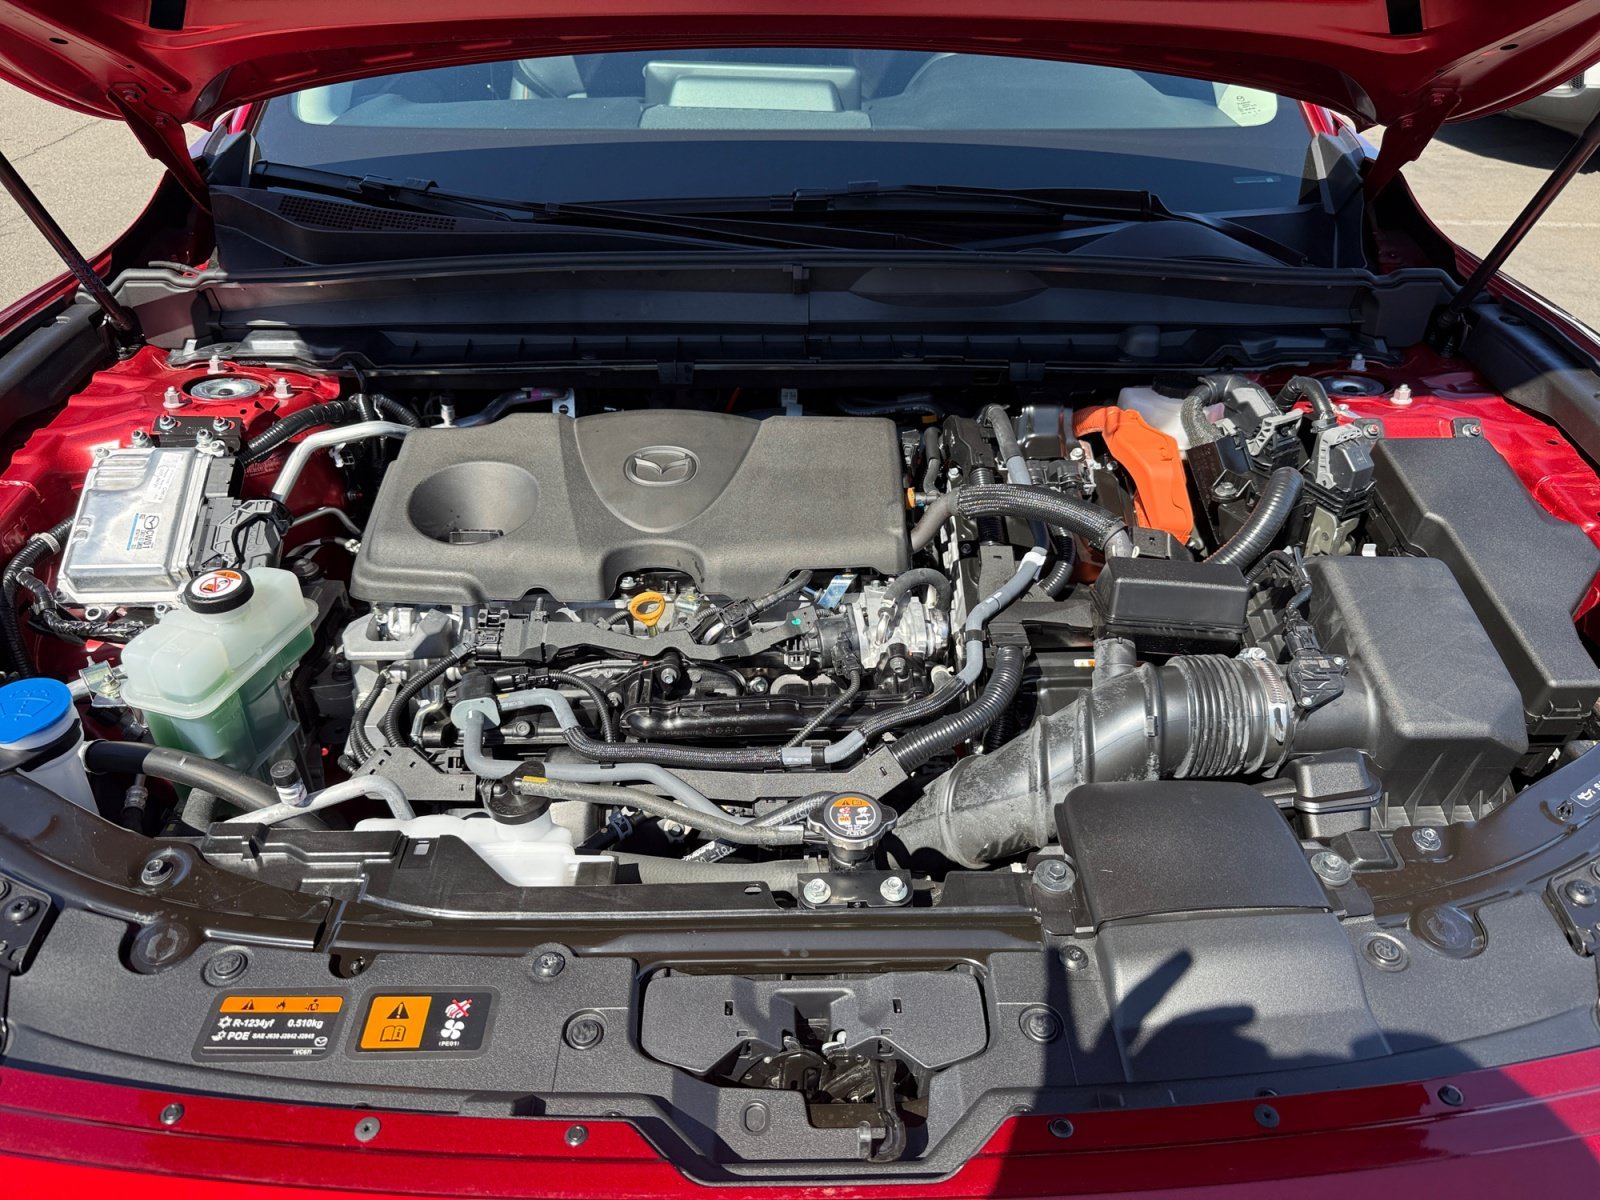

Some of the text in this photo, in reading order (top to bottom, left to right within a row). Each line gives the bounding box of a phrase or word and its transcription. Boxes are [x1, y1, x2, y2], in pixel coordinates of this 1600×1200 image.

[232, 1018, 324, 1029] R-1234yf 0.510kg
[227, 1031, 249, 1040] POE
